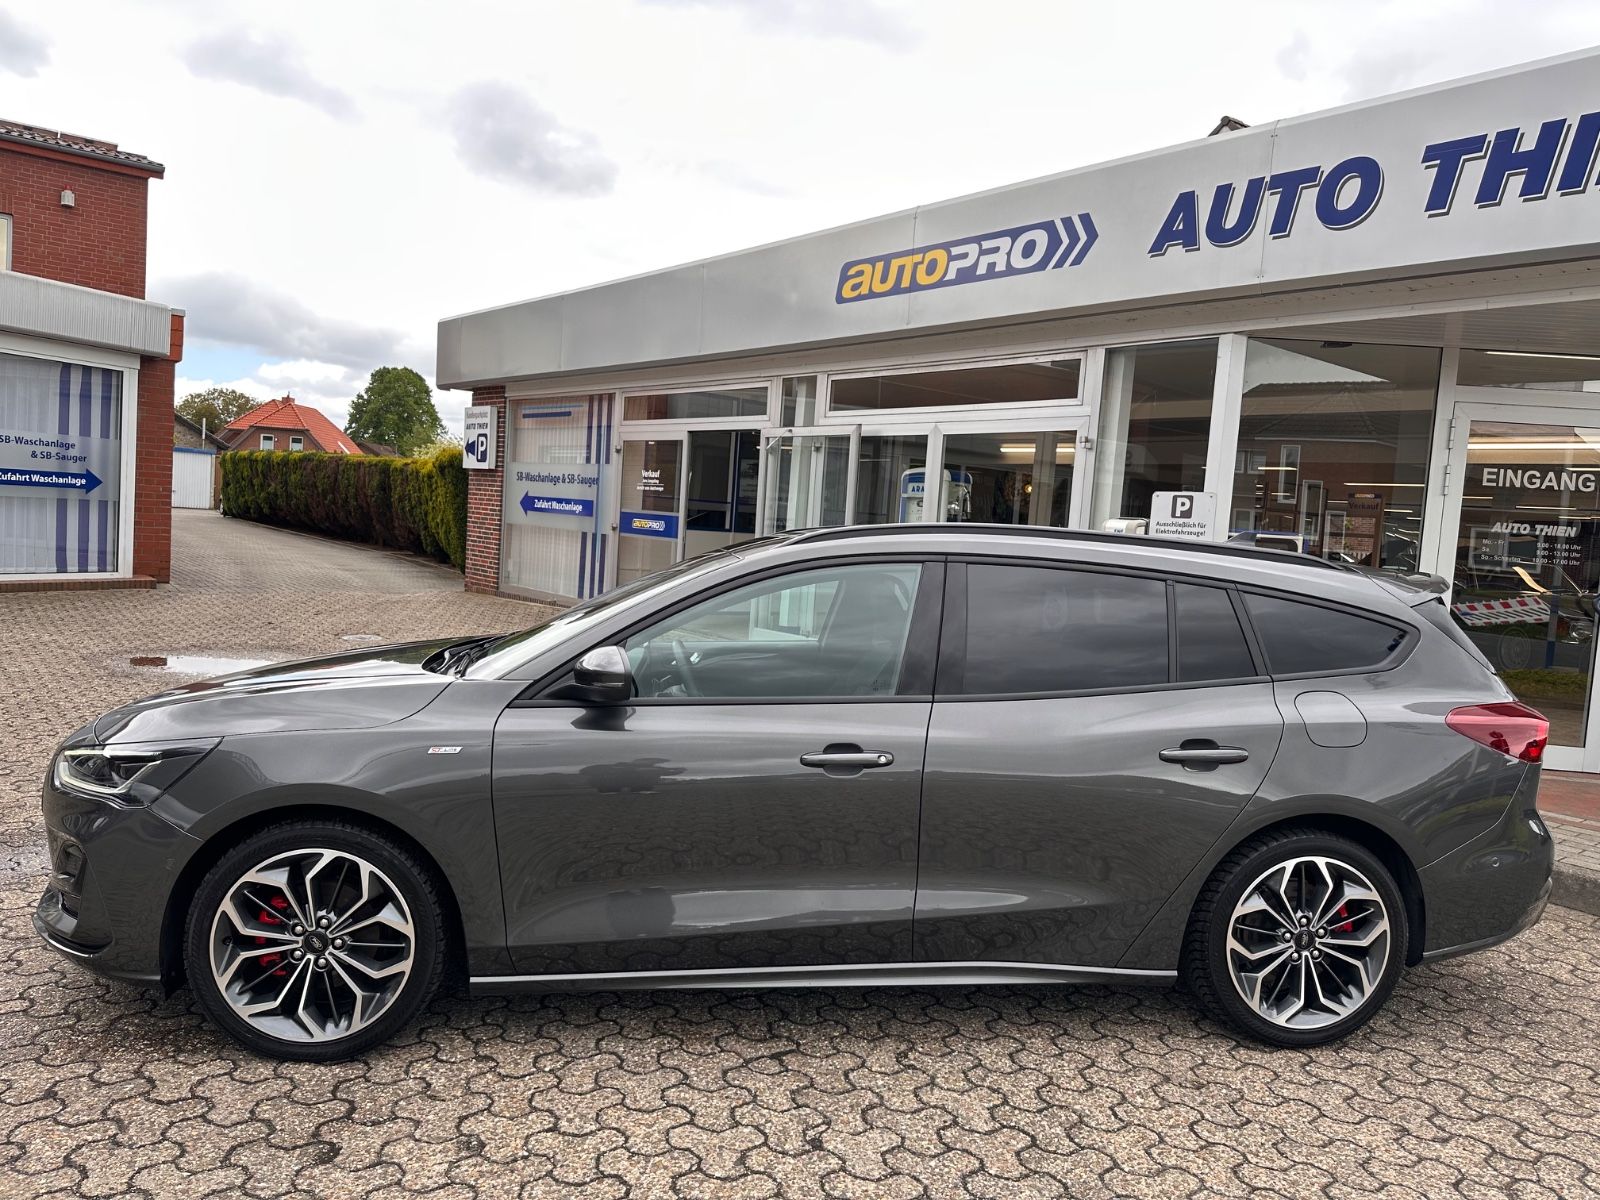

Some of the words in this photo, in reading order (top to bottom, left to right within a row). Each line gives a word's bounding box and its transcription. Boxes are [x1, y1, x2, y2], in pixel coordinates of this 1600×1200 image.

[1148, 155, 1384, 258] AUTO
[1421, 111, 1600, 218] THI
[0, 434, 76, 450] SB-Waschanlage
[31, 450, 38, 459] &
[40, 451, 87, 463] SB-Sauger
[31, 474, 86, 486] Waschanlage
[516, 472, 560, 485] SB-Waschanlage
[562, 473, 566, 484] &
[567, 473, 599, 487] SB-Sauger
[641, 469, 660, 478] Verkauf
[1482, 467, 1596, 492] EINGANG
[912, 485, 925, 493] ARA
[534, 499, 552, 509] Zufahrt
[552, 501, 583, 514] Waschanlage
[1155, 528, 1206, 537] Elektrofahrzeuge!
[1491, 522, 1530, 535] AUTO
[1535, 524, 1577, 537] THIEN
